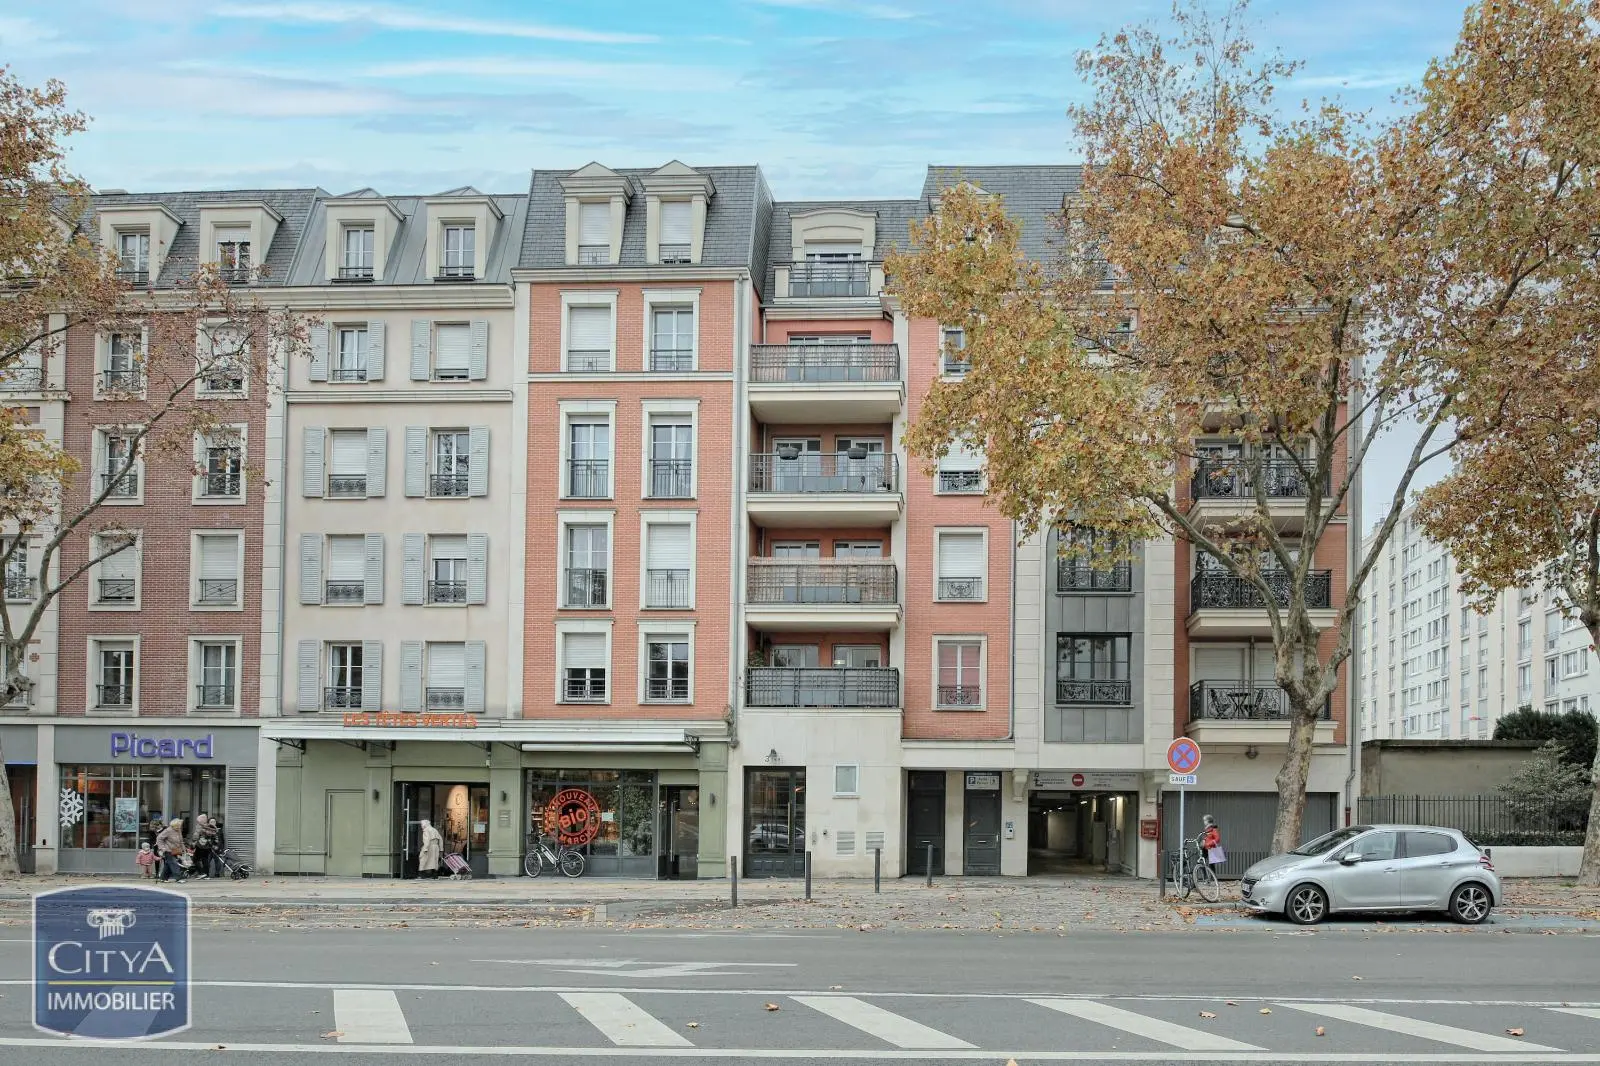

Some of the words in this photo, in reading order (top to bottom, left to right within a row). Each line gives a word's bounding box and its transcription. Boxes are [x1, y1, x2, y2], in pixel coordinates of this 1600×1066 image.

[343, 712, 370, 727] LES
[423, 713, 478, 728] VERTES
[111, 732, 214, 758] Picard
